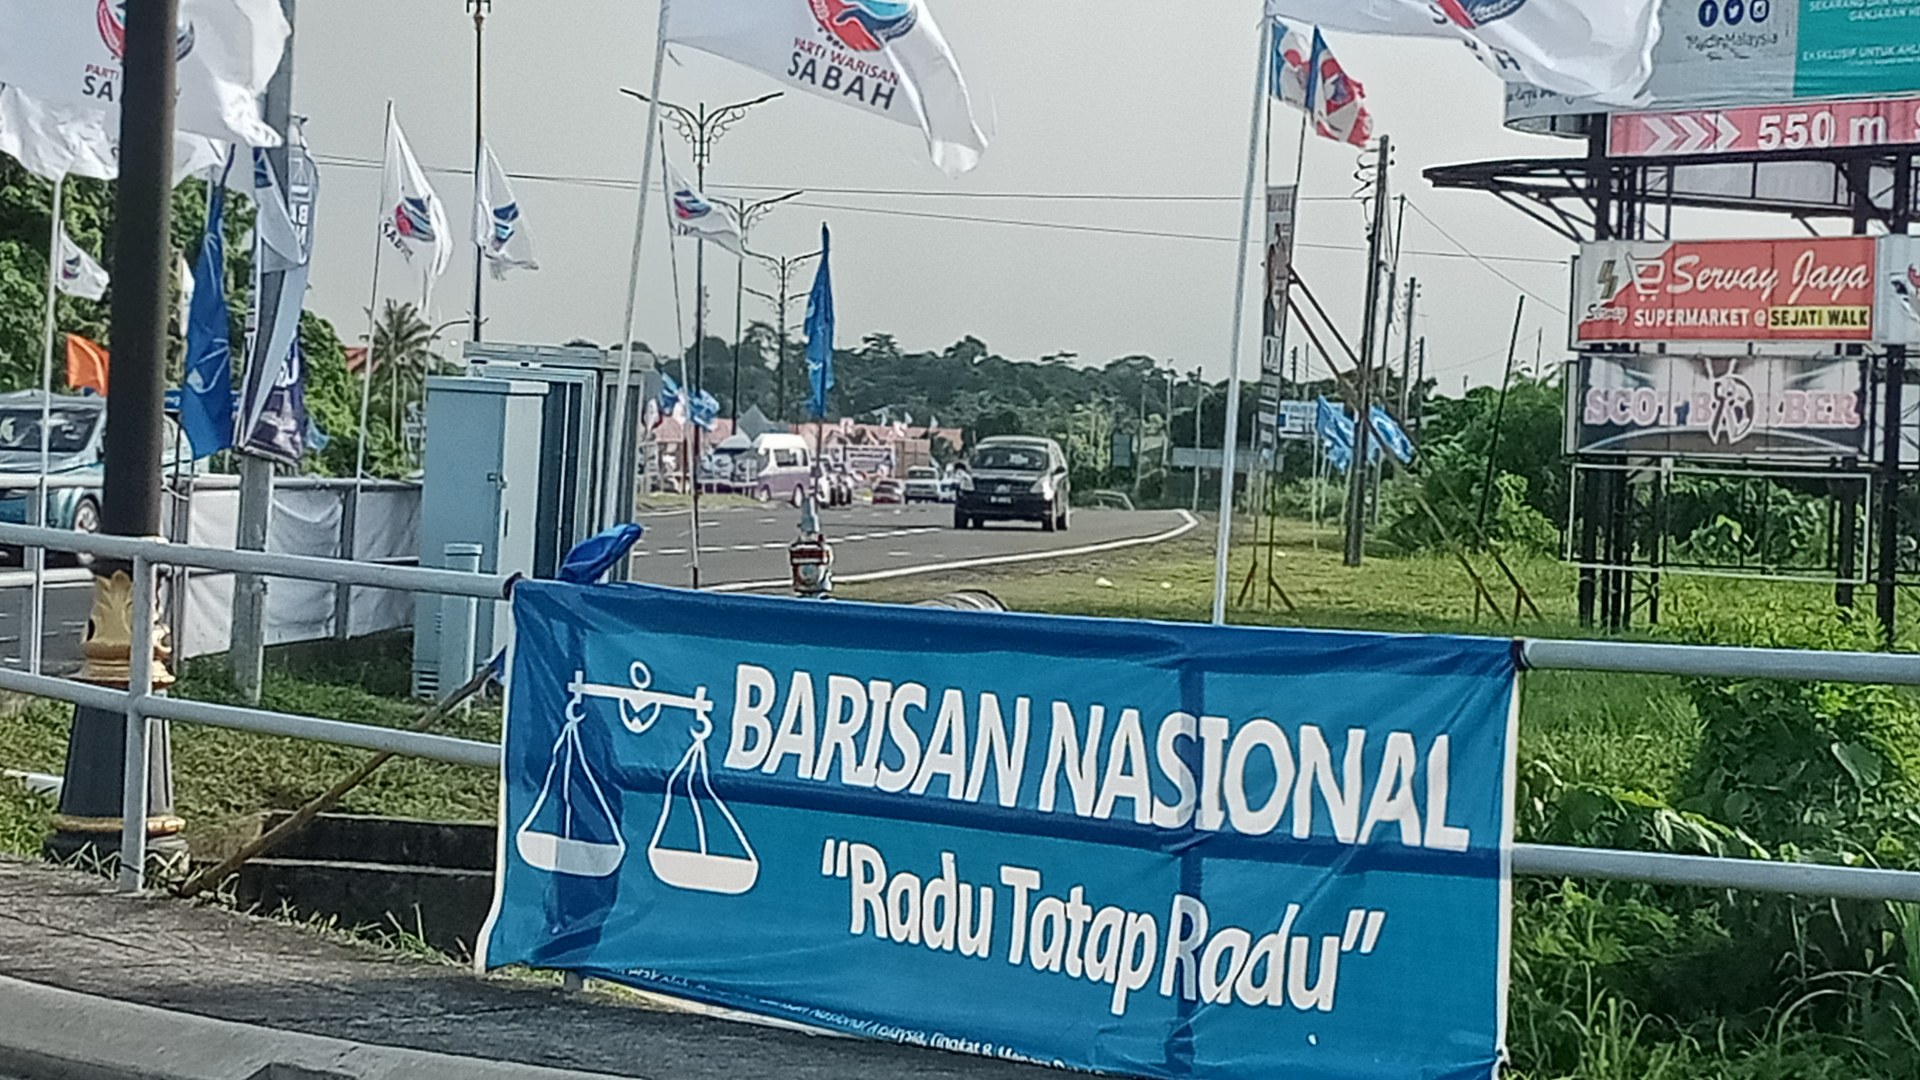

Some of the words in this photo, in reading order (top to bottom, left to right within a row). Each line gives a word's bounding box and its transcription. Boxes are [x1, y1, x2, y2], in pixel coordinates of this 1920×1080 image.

[787, 51, 896, 111] SABAH
[794, 37, 826, 60] PARTI
[831, 50, 900, 86] WARISAN
[1757, 110, 1836, 151] 550
[1850, 116, 1887, 146] m
[1666, 254, 1779, 302] Servay
[1787, 249, 1871, 305] Jaya
[1634, 308, 1750, 327] SUPERMARKET
[1770, 309, 1823, 326] SEJATI
[1827, 309, 1868, 326] WALK
[1583, 387, 1677, 426] SCOT
[724, 663, 1030, 808] BARISAN
[1038, 701, 1470, 852] NASIONAL
[1000, 865, 1157, 1016] Tatap
